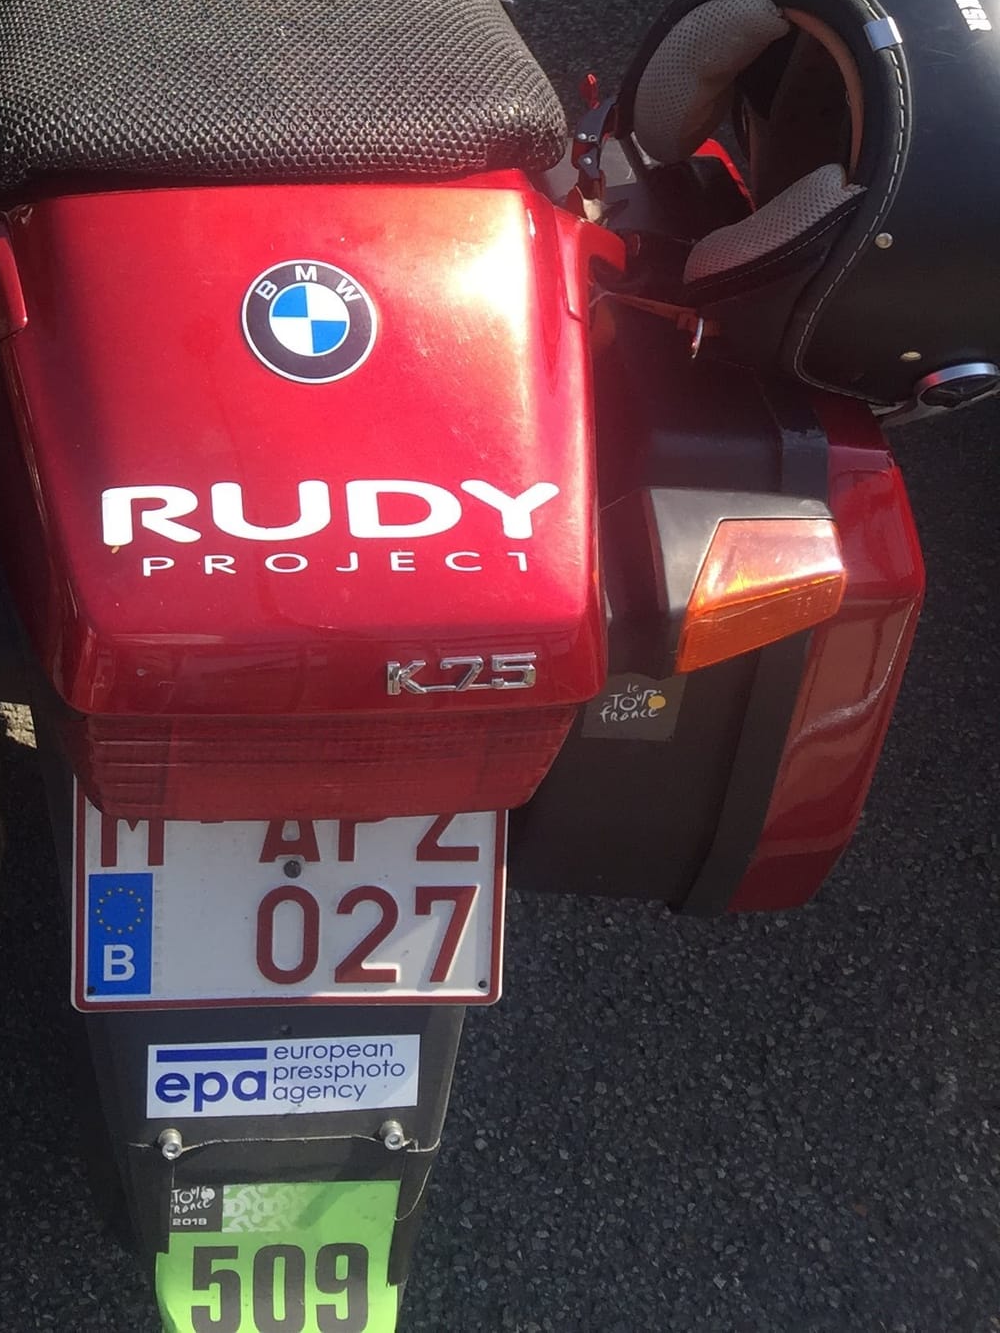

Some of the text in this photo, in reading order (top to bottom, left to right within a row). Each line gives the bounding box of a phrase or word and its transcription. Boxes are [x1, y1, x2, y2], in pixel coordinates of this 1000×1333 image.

[255, 265, 362, 303] BMW
[101, 479, 560, 546] RUDY
[387, 652, 537, 696] K75
[256, 884, 478, 985] 027
[103, 944, 136, 982] B
[273, 1043, 394, 1062] european
[155, 1070, 267, 1112] epa
[273, 1060, 405, 1084] pressphoto
[273, 1084, 367, 1104] agency
[172, 1218, 208, 1226] 2018
[191, 1242, 369, 1333] 509
